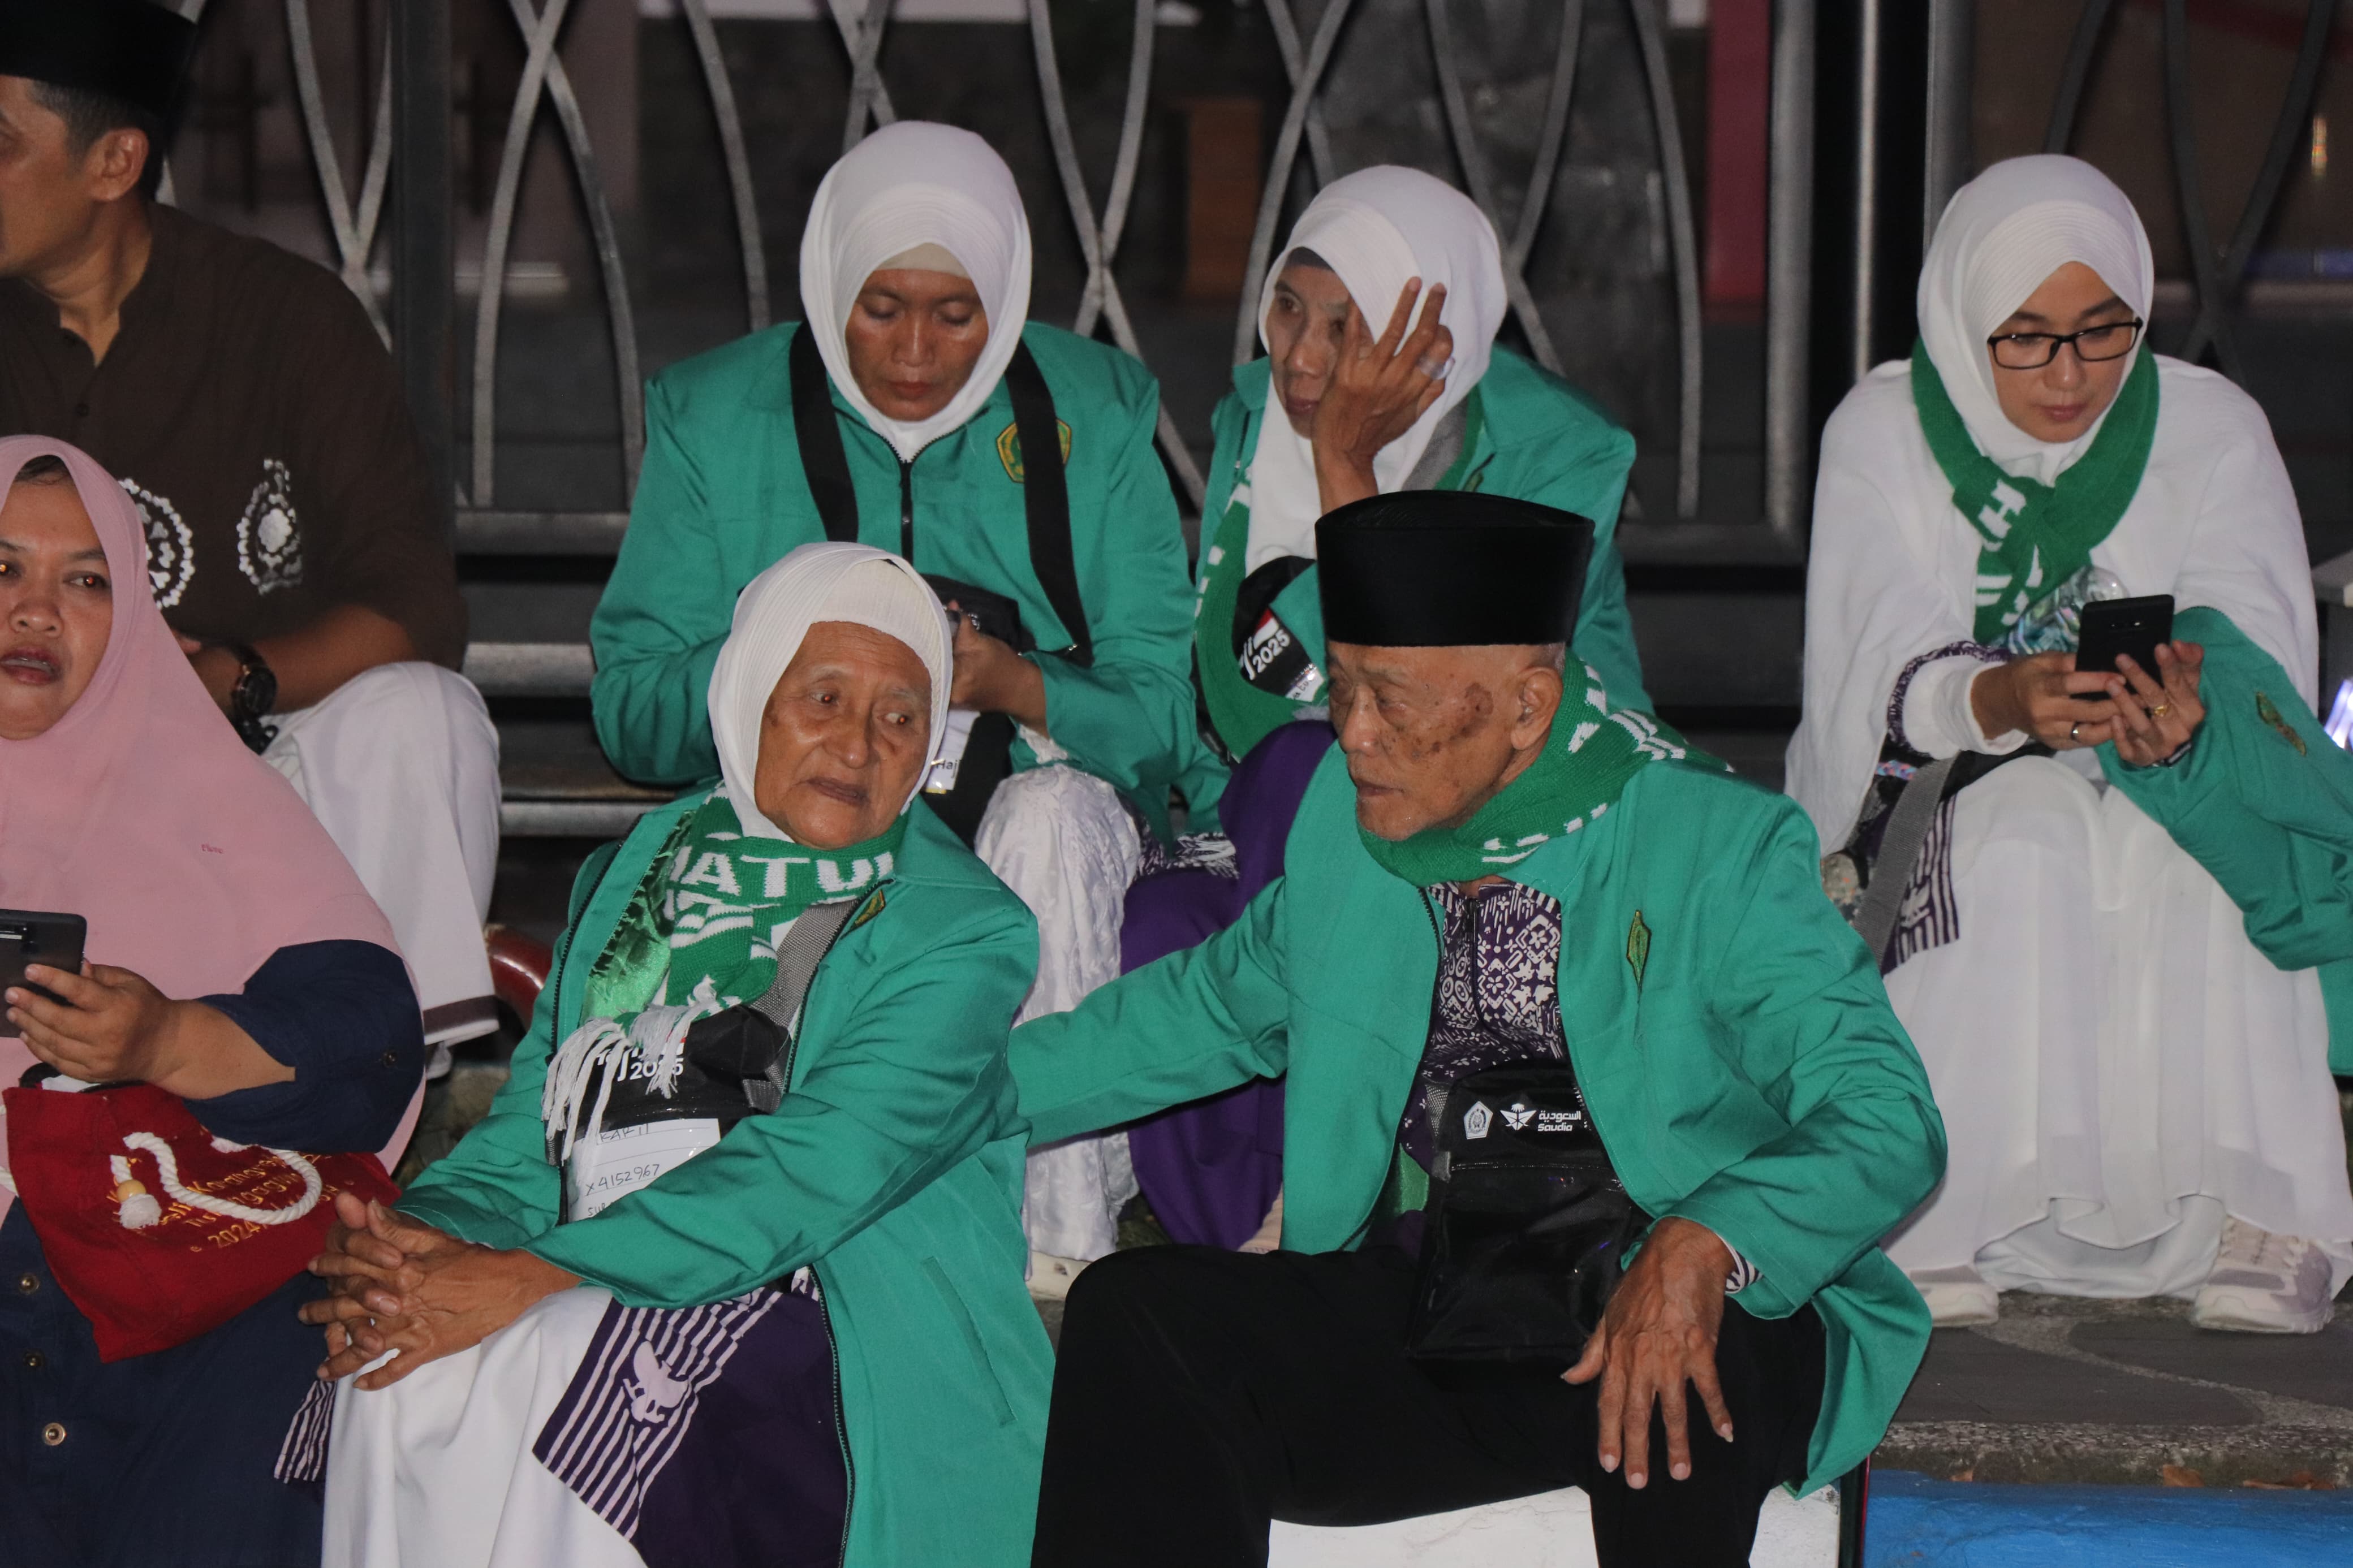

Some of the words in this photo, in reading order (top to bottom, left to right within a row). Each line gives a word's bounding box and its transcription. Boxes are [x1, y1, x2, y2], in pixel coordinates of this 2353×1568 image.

[1252, 629, 1290, 673] 2025
[630, 1057, 684, 1081] 205
[1537, 1123, 1573, 1131] Saudia
